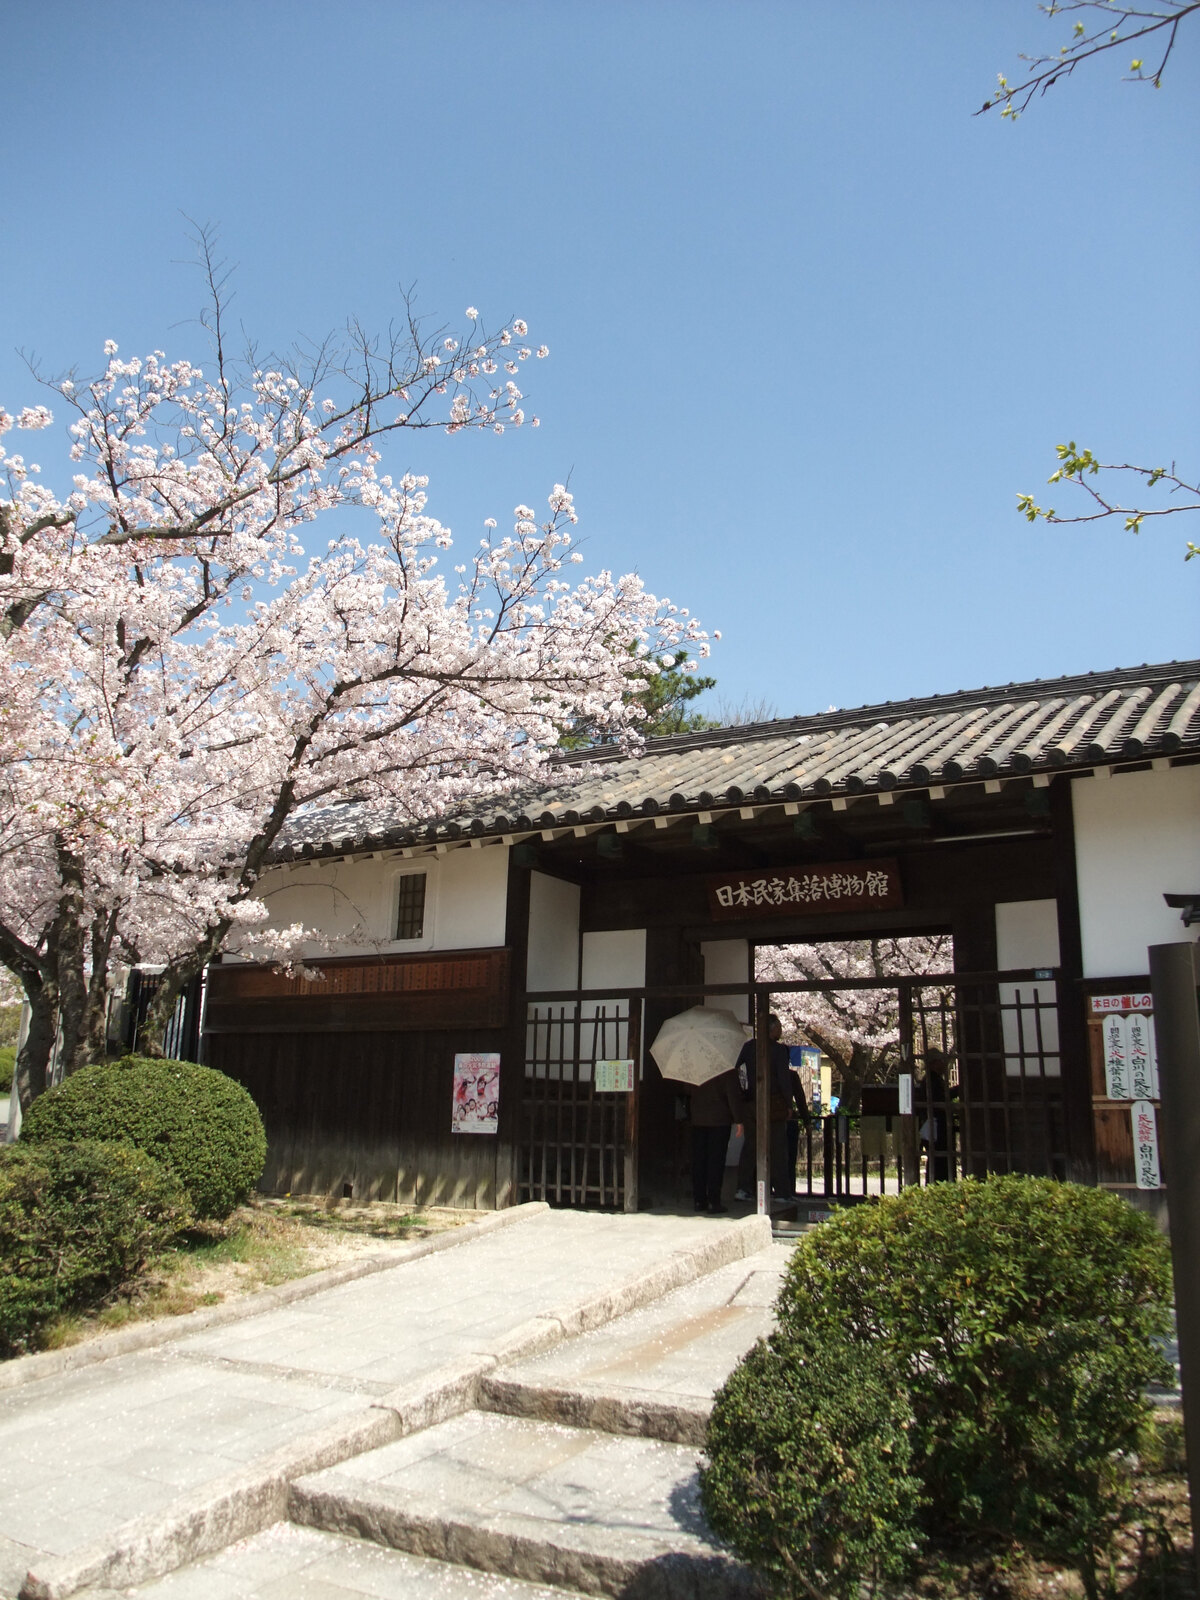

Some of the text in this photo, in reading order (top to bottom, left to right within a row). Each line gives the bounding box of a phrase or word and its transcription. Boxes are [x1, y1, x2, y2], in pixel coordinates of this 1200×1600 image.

[715, 871, 889, 907] 日本民家集落博物館
